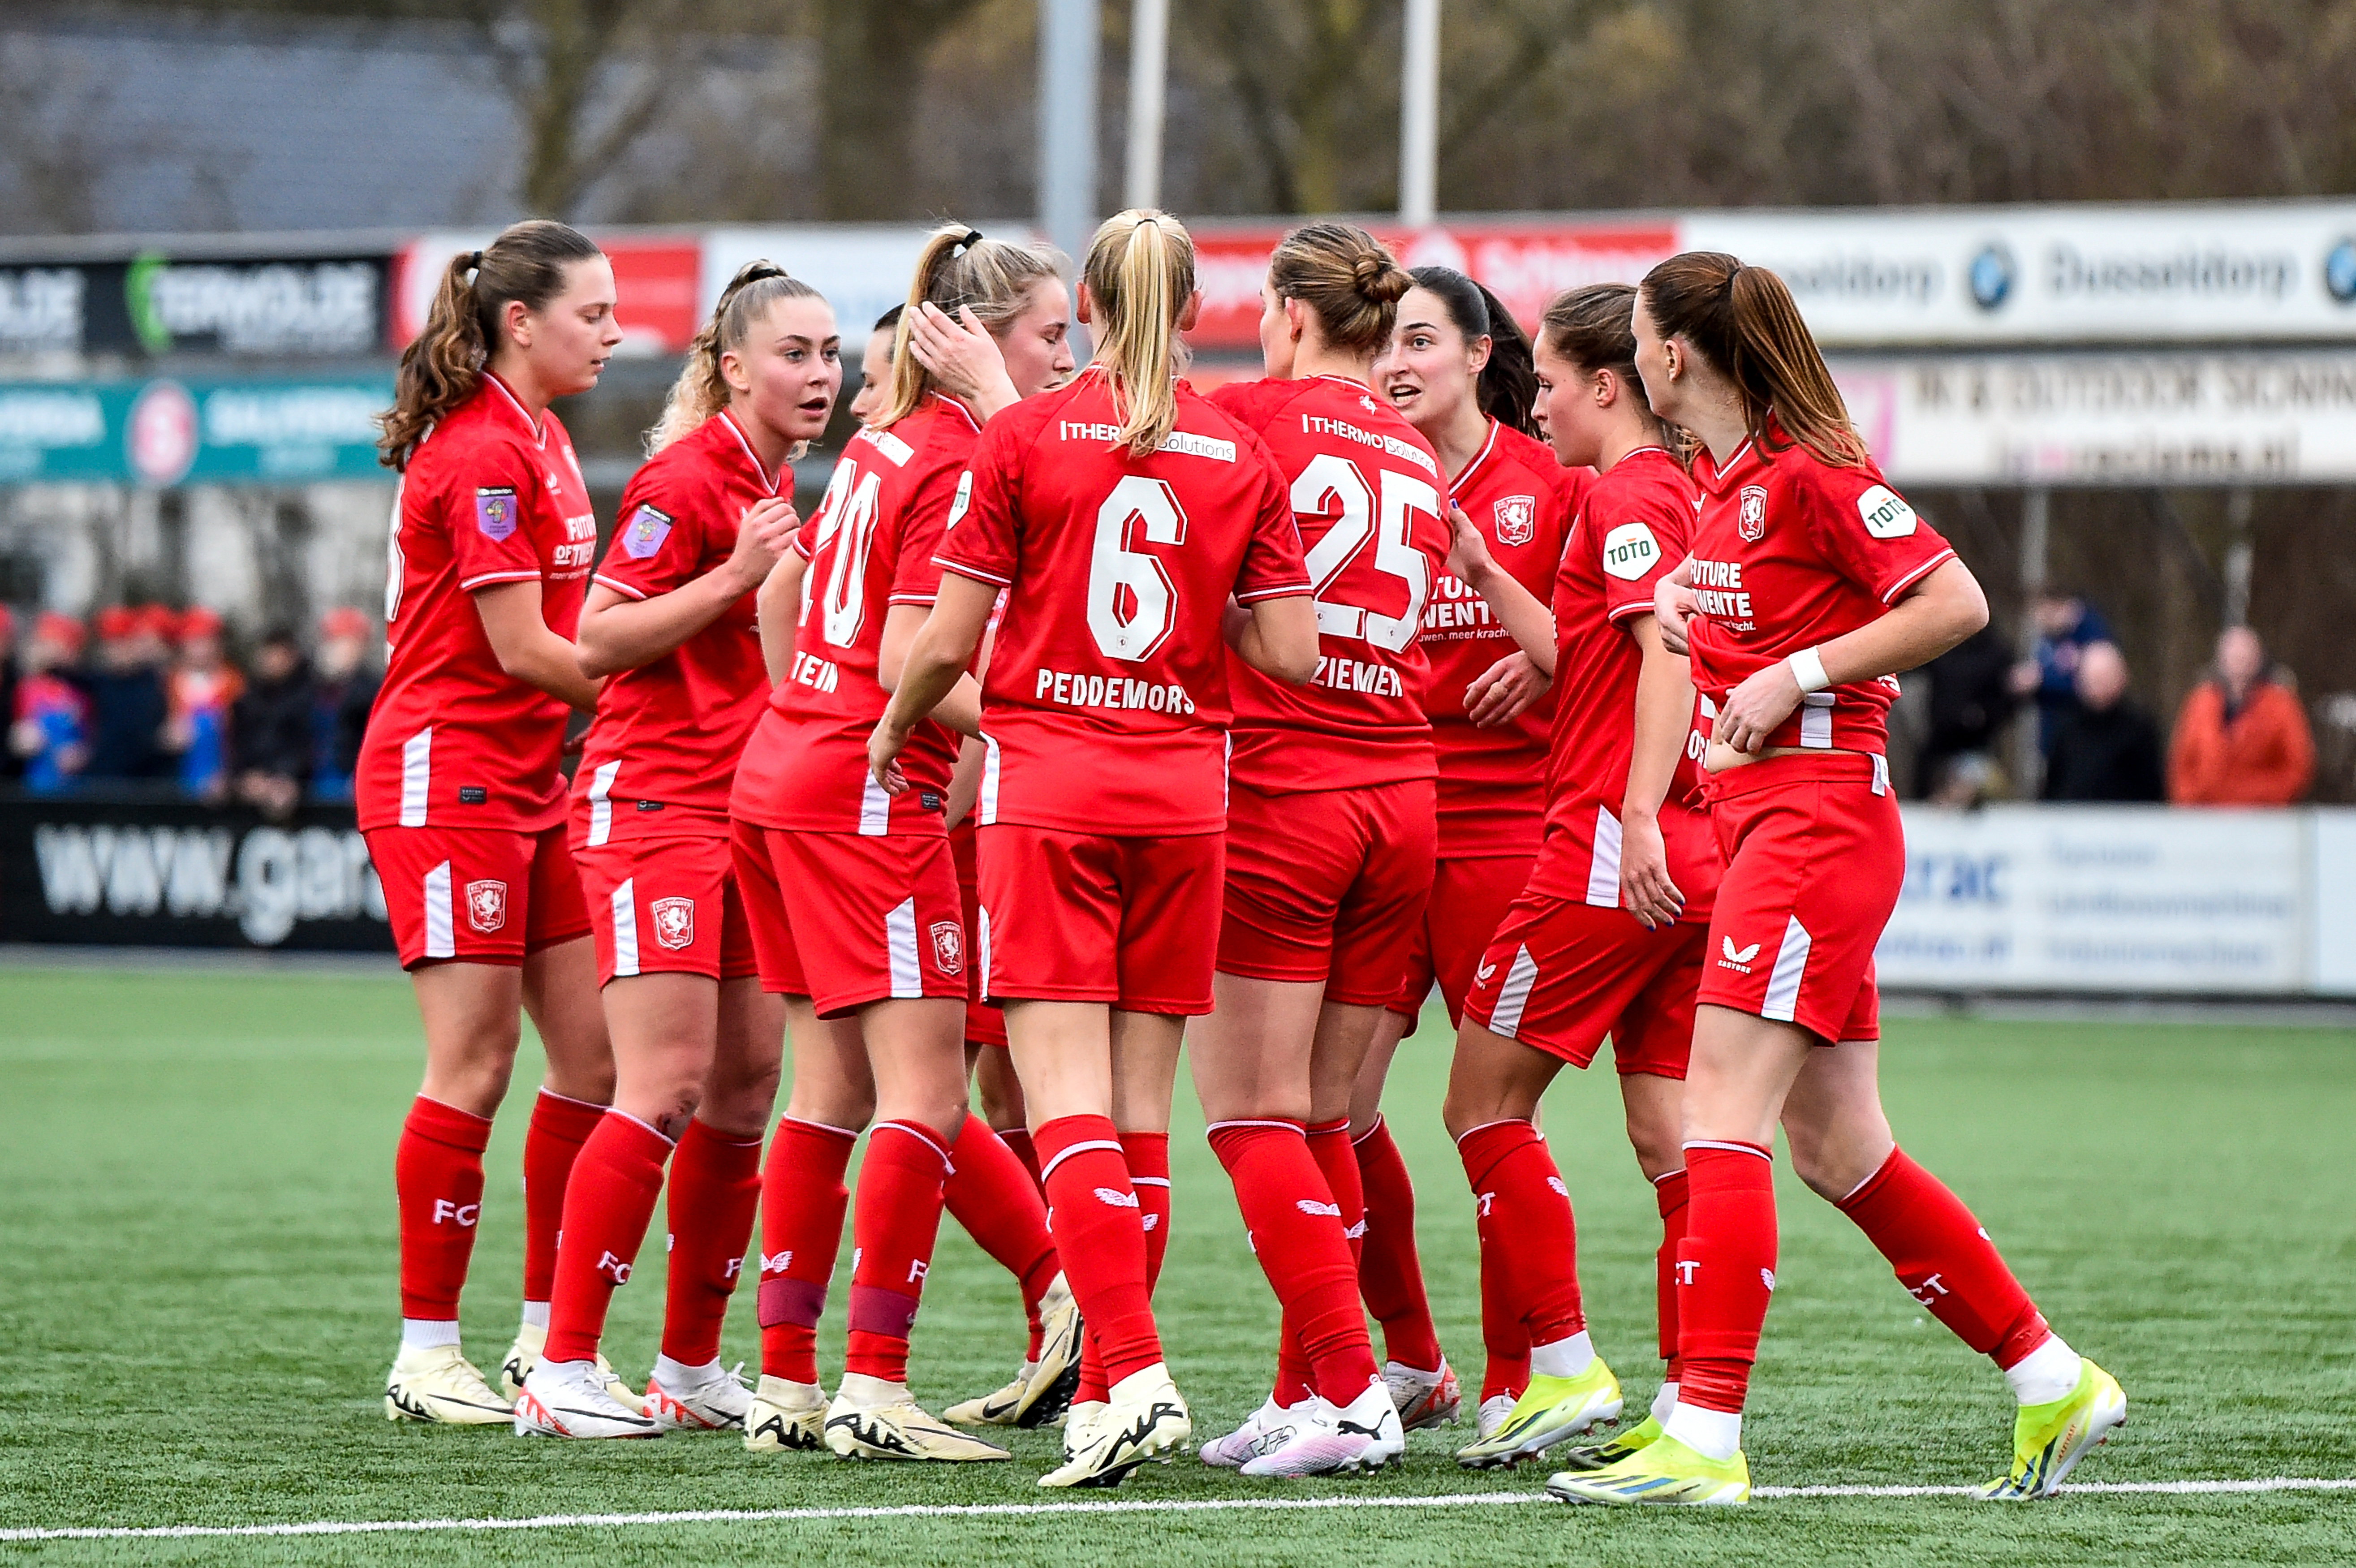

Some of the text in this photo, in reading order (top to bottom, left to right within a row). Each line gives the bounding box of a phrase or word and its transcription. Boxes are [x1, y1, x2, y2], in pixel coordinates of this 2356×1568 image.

[1868, 499, 1907, 528] TOTO
[1087, 475, 1188, 663] 6
[1290, 453, 1442, 654] 25
[1607, 540, 1650, 565] TOTO
[1693, 588, 1753, 617] WENTE
[1449, 629, 1475, 641] meer
[790, 650, 838, 693] TEIN
[1036, 668, 1195, 715] PEDDEMORS
